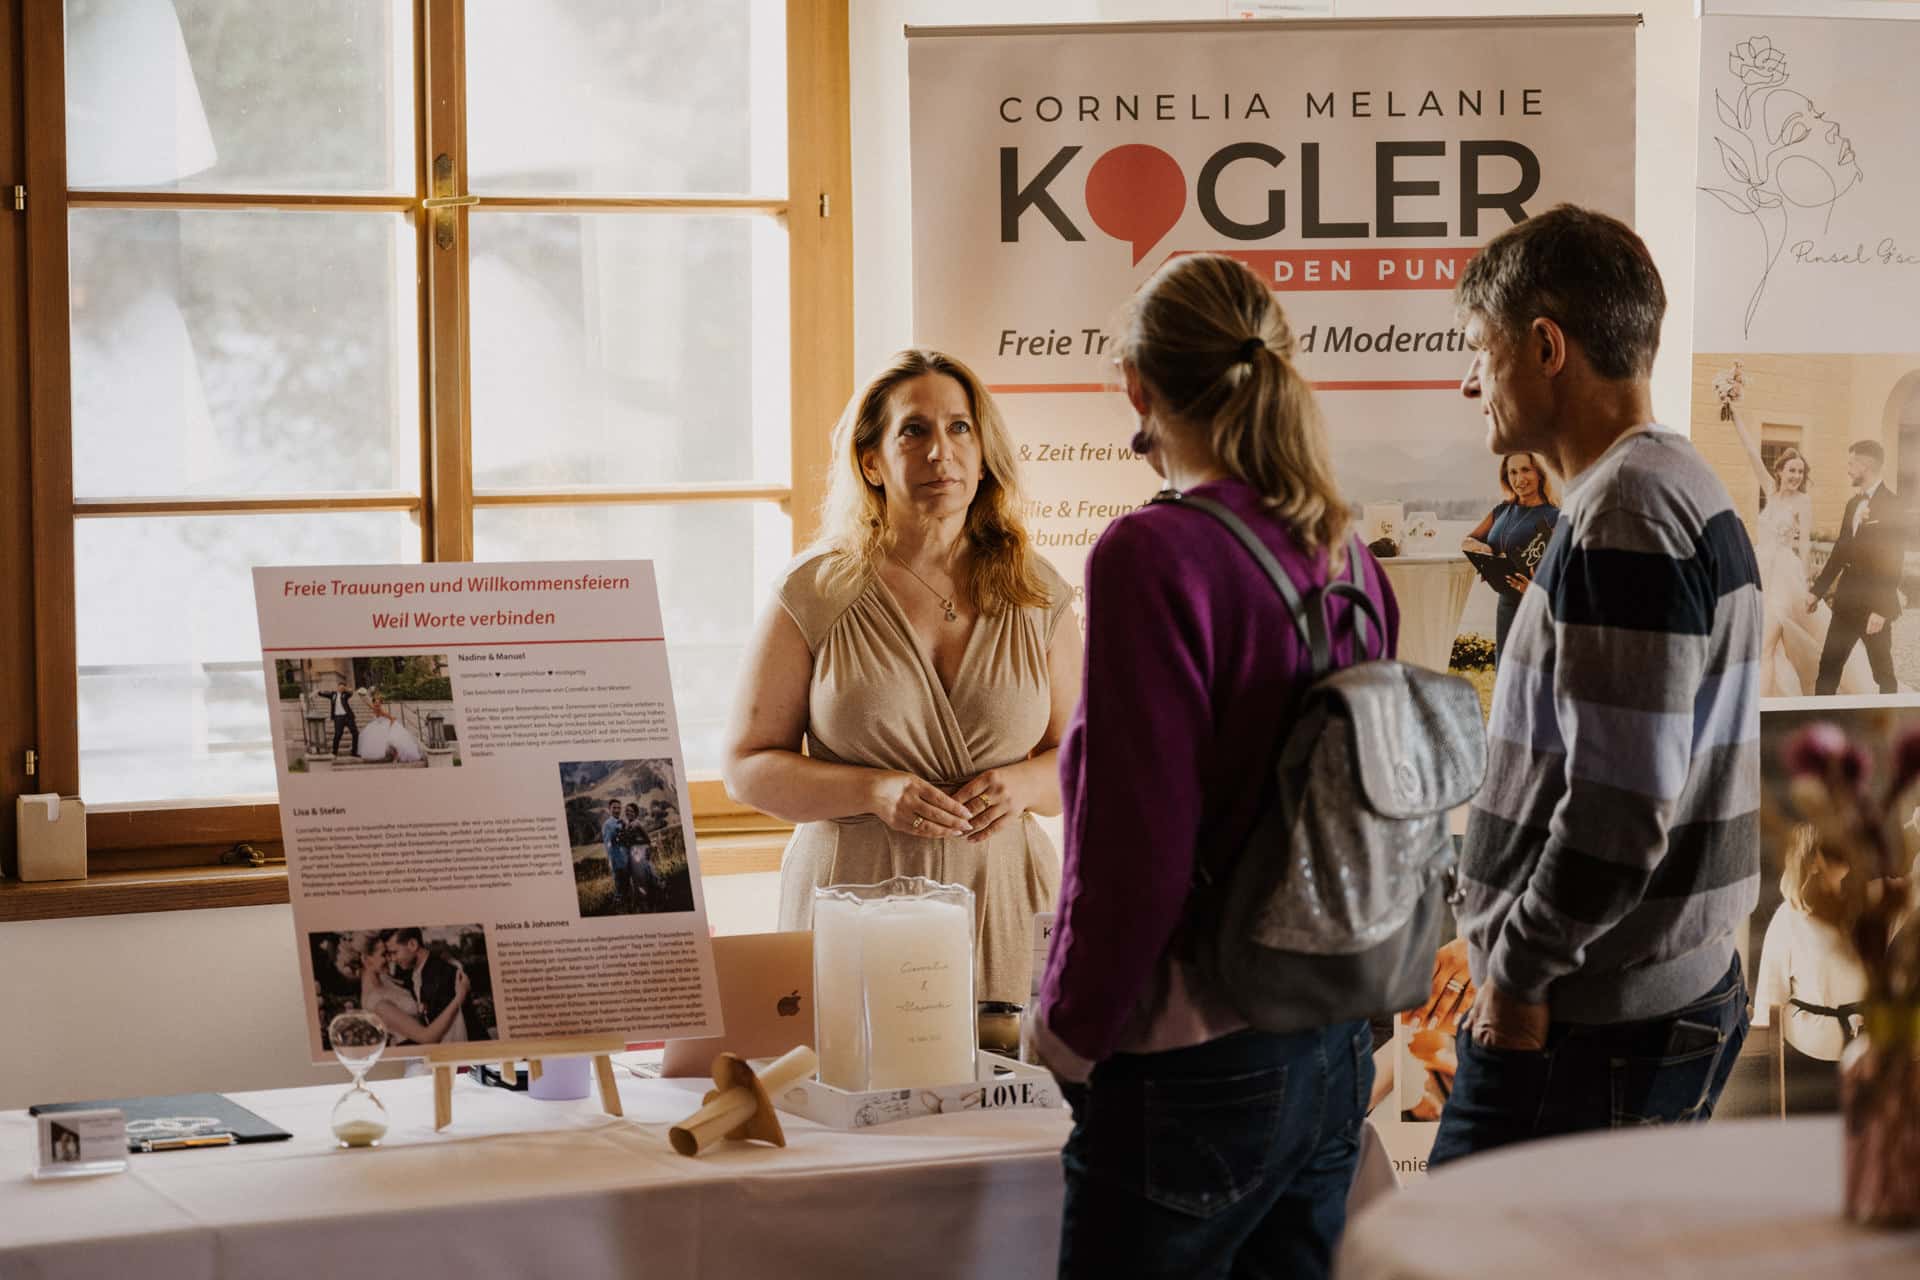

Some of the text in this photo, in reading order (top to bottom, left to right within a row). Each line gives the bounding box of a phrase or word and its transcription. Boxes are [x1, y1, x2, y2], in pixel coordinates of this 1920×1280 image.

[1000, 88, 1543, 123] CORNELIA MELANIE
[1274, 258, 1472, 282] DEN PUN
[998, 328, 1073, 357] Freie
[1322, 323, 1467, 353] Moderati
[1036, 443, 1075, 461] Zeit
[1079, 442, 1113, 462] frei
[1057, 500, 1073, 518] &
[284, 574, 630, 598] Freie Trauungen und Willkommensfeiern
[372, 608, 556, 629] Weil Worte verbinden
[458, 653, 487, 662] Nadine
[496, 652, 526, 661] Manuel
[293, 808, 310, 817] Lisa
[319, 806, 346, 816] Stefan
[496, 921, 522, 930] Jessica
[532, 919, 570, 928] Johannes
[980, 1082, 1034, 1108] LOVE
